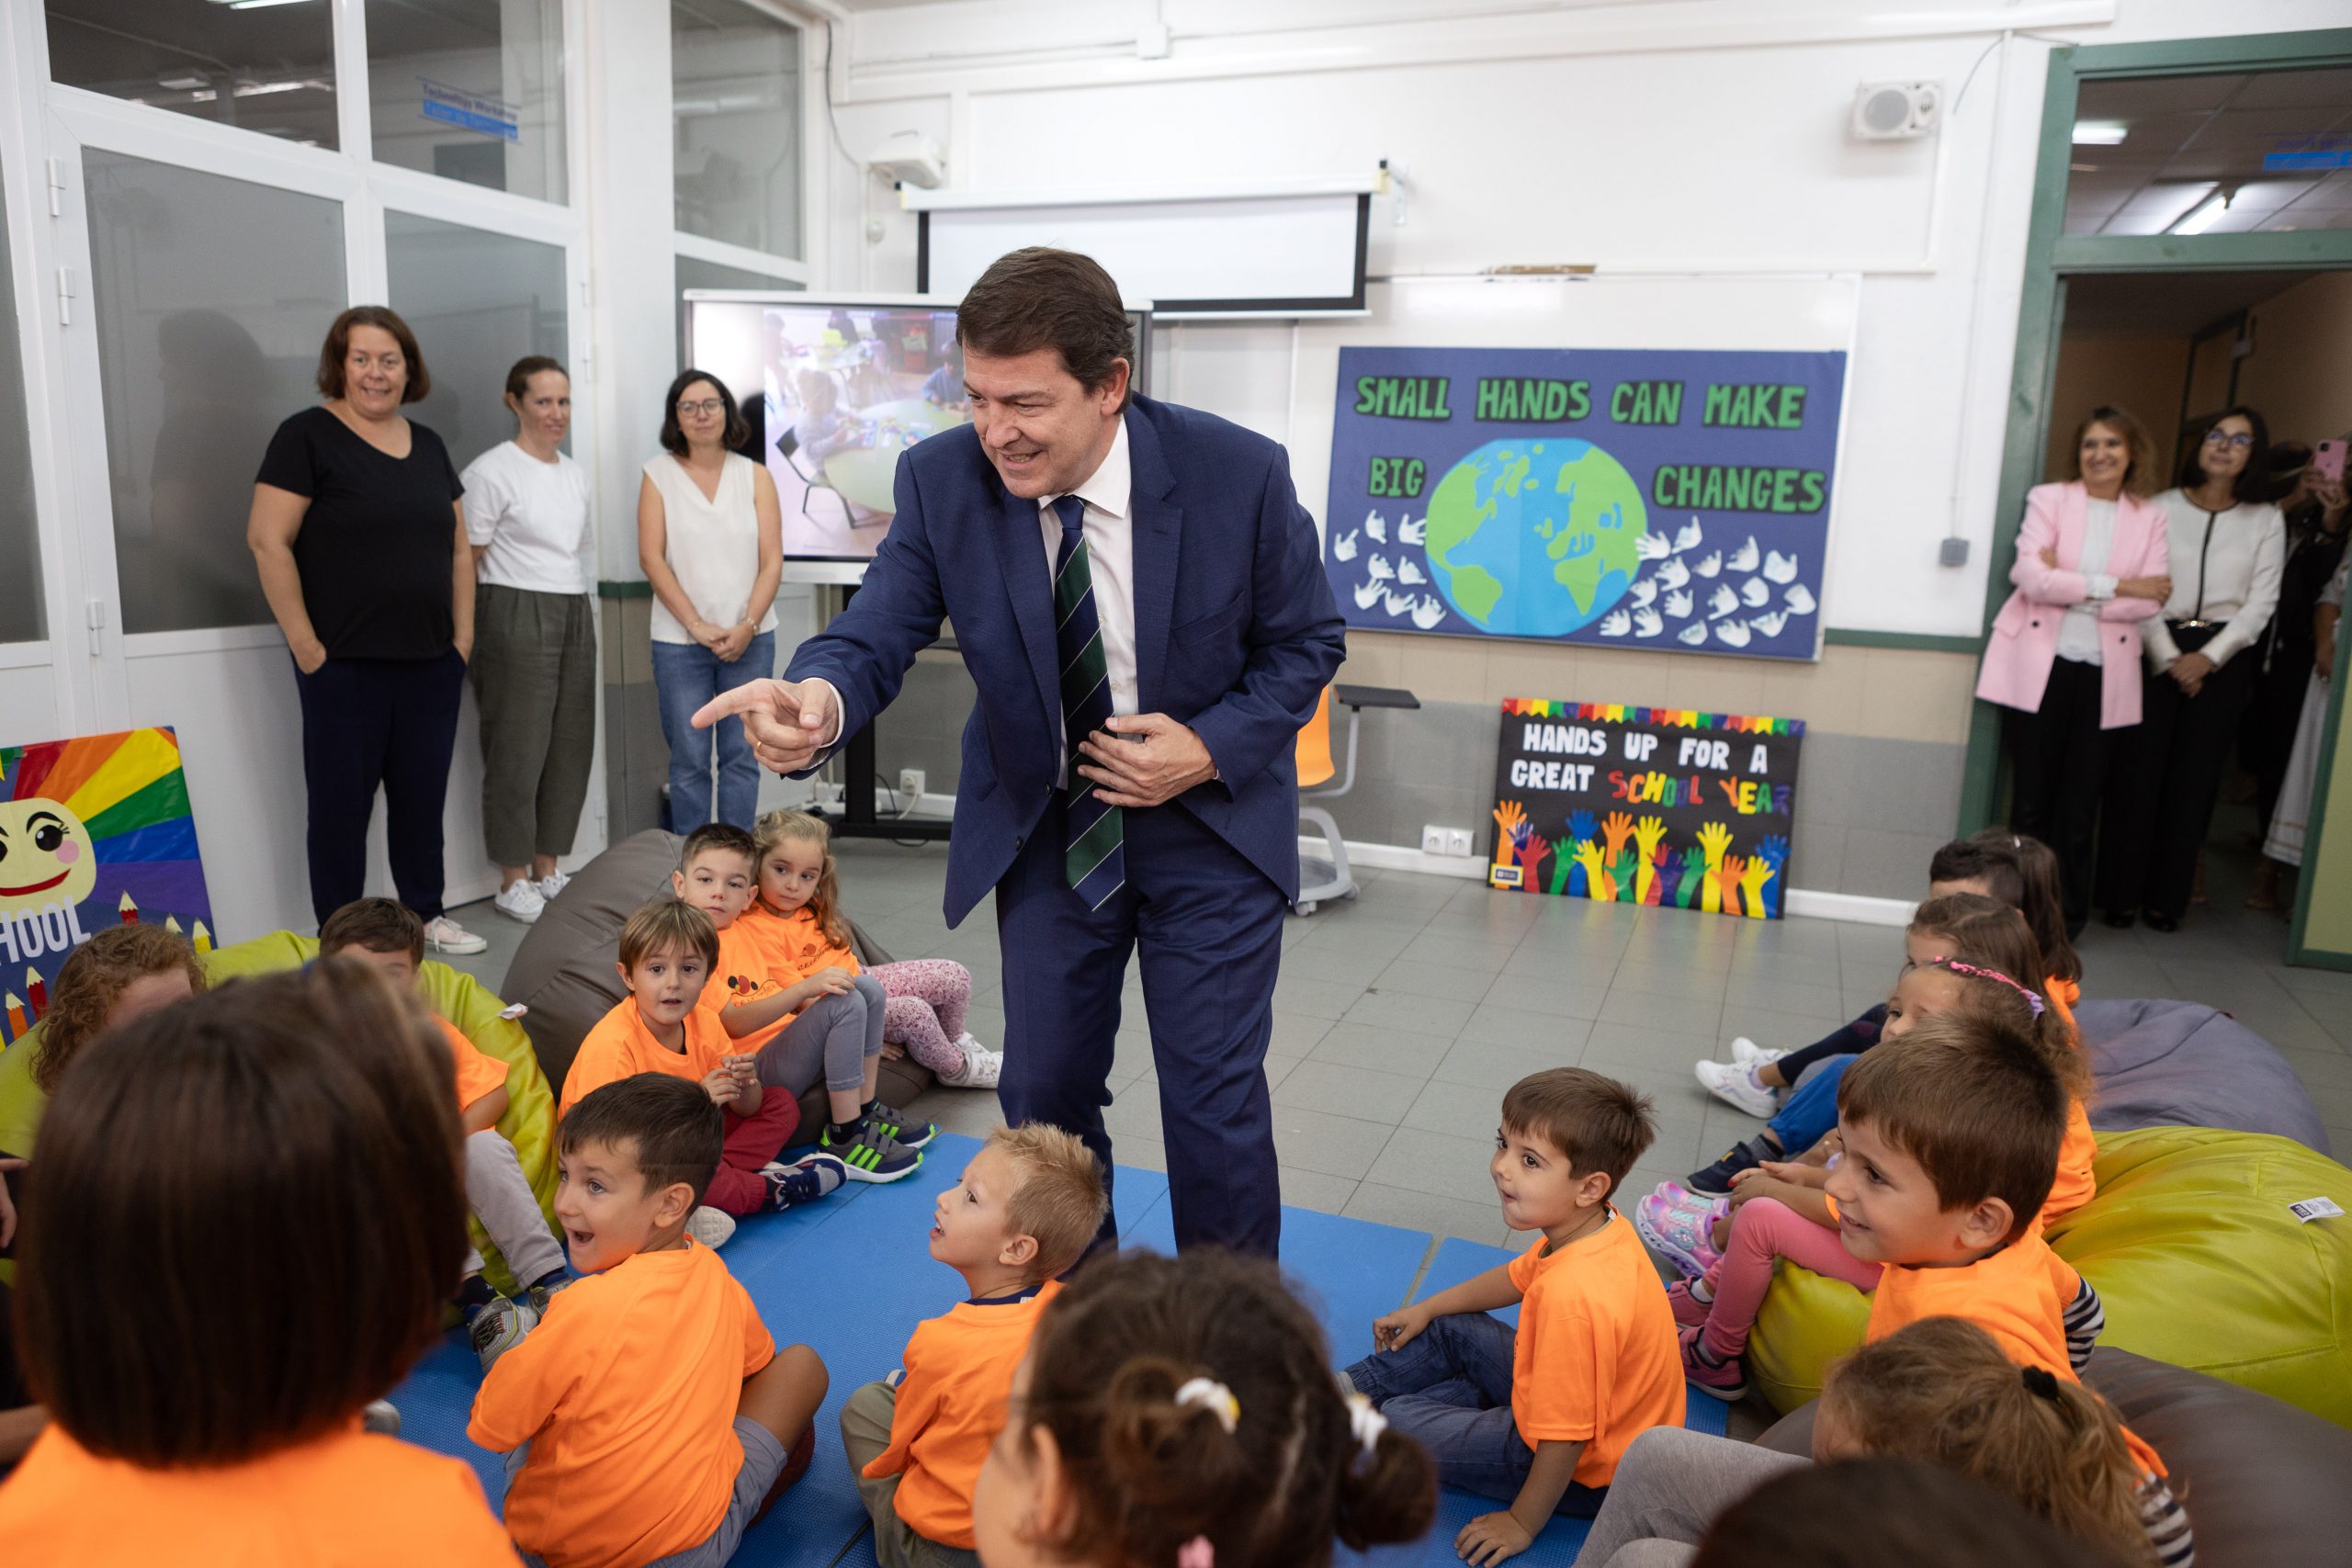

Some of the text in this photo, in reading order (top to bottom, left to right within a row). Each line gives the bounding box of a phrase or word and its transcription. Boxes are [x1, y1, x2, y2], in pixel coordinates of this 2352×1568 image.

[1354, 376, 1807, 428] SMALL HANDS CAN MAKE
[1369, 457, 1826, 513] BIG CHANGES
[1523, 723, 1768, 773] HANDS UP FOR A
[1510, 760, 1792, 816] GREAT SCHOOL YEAR
